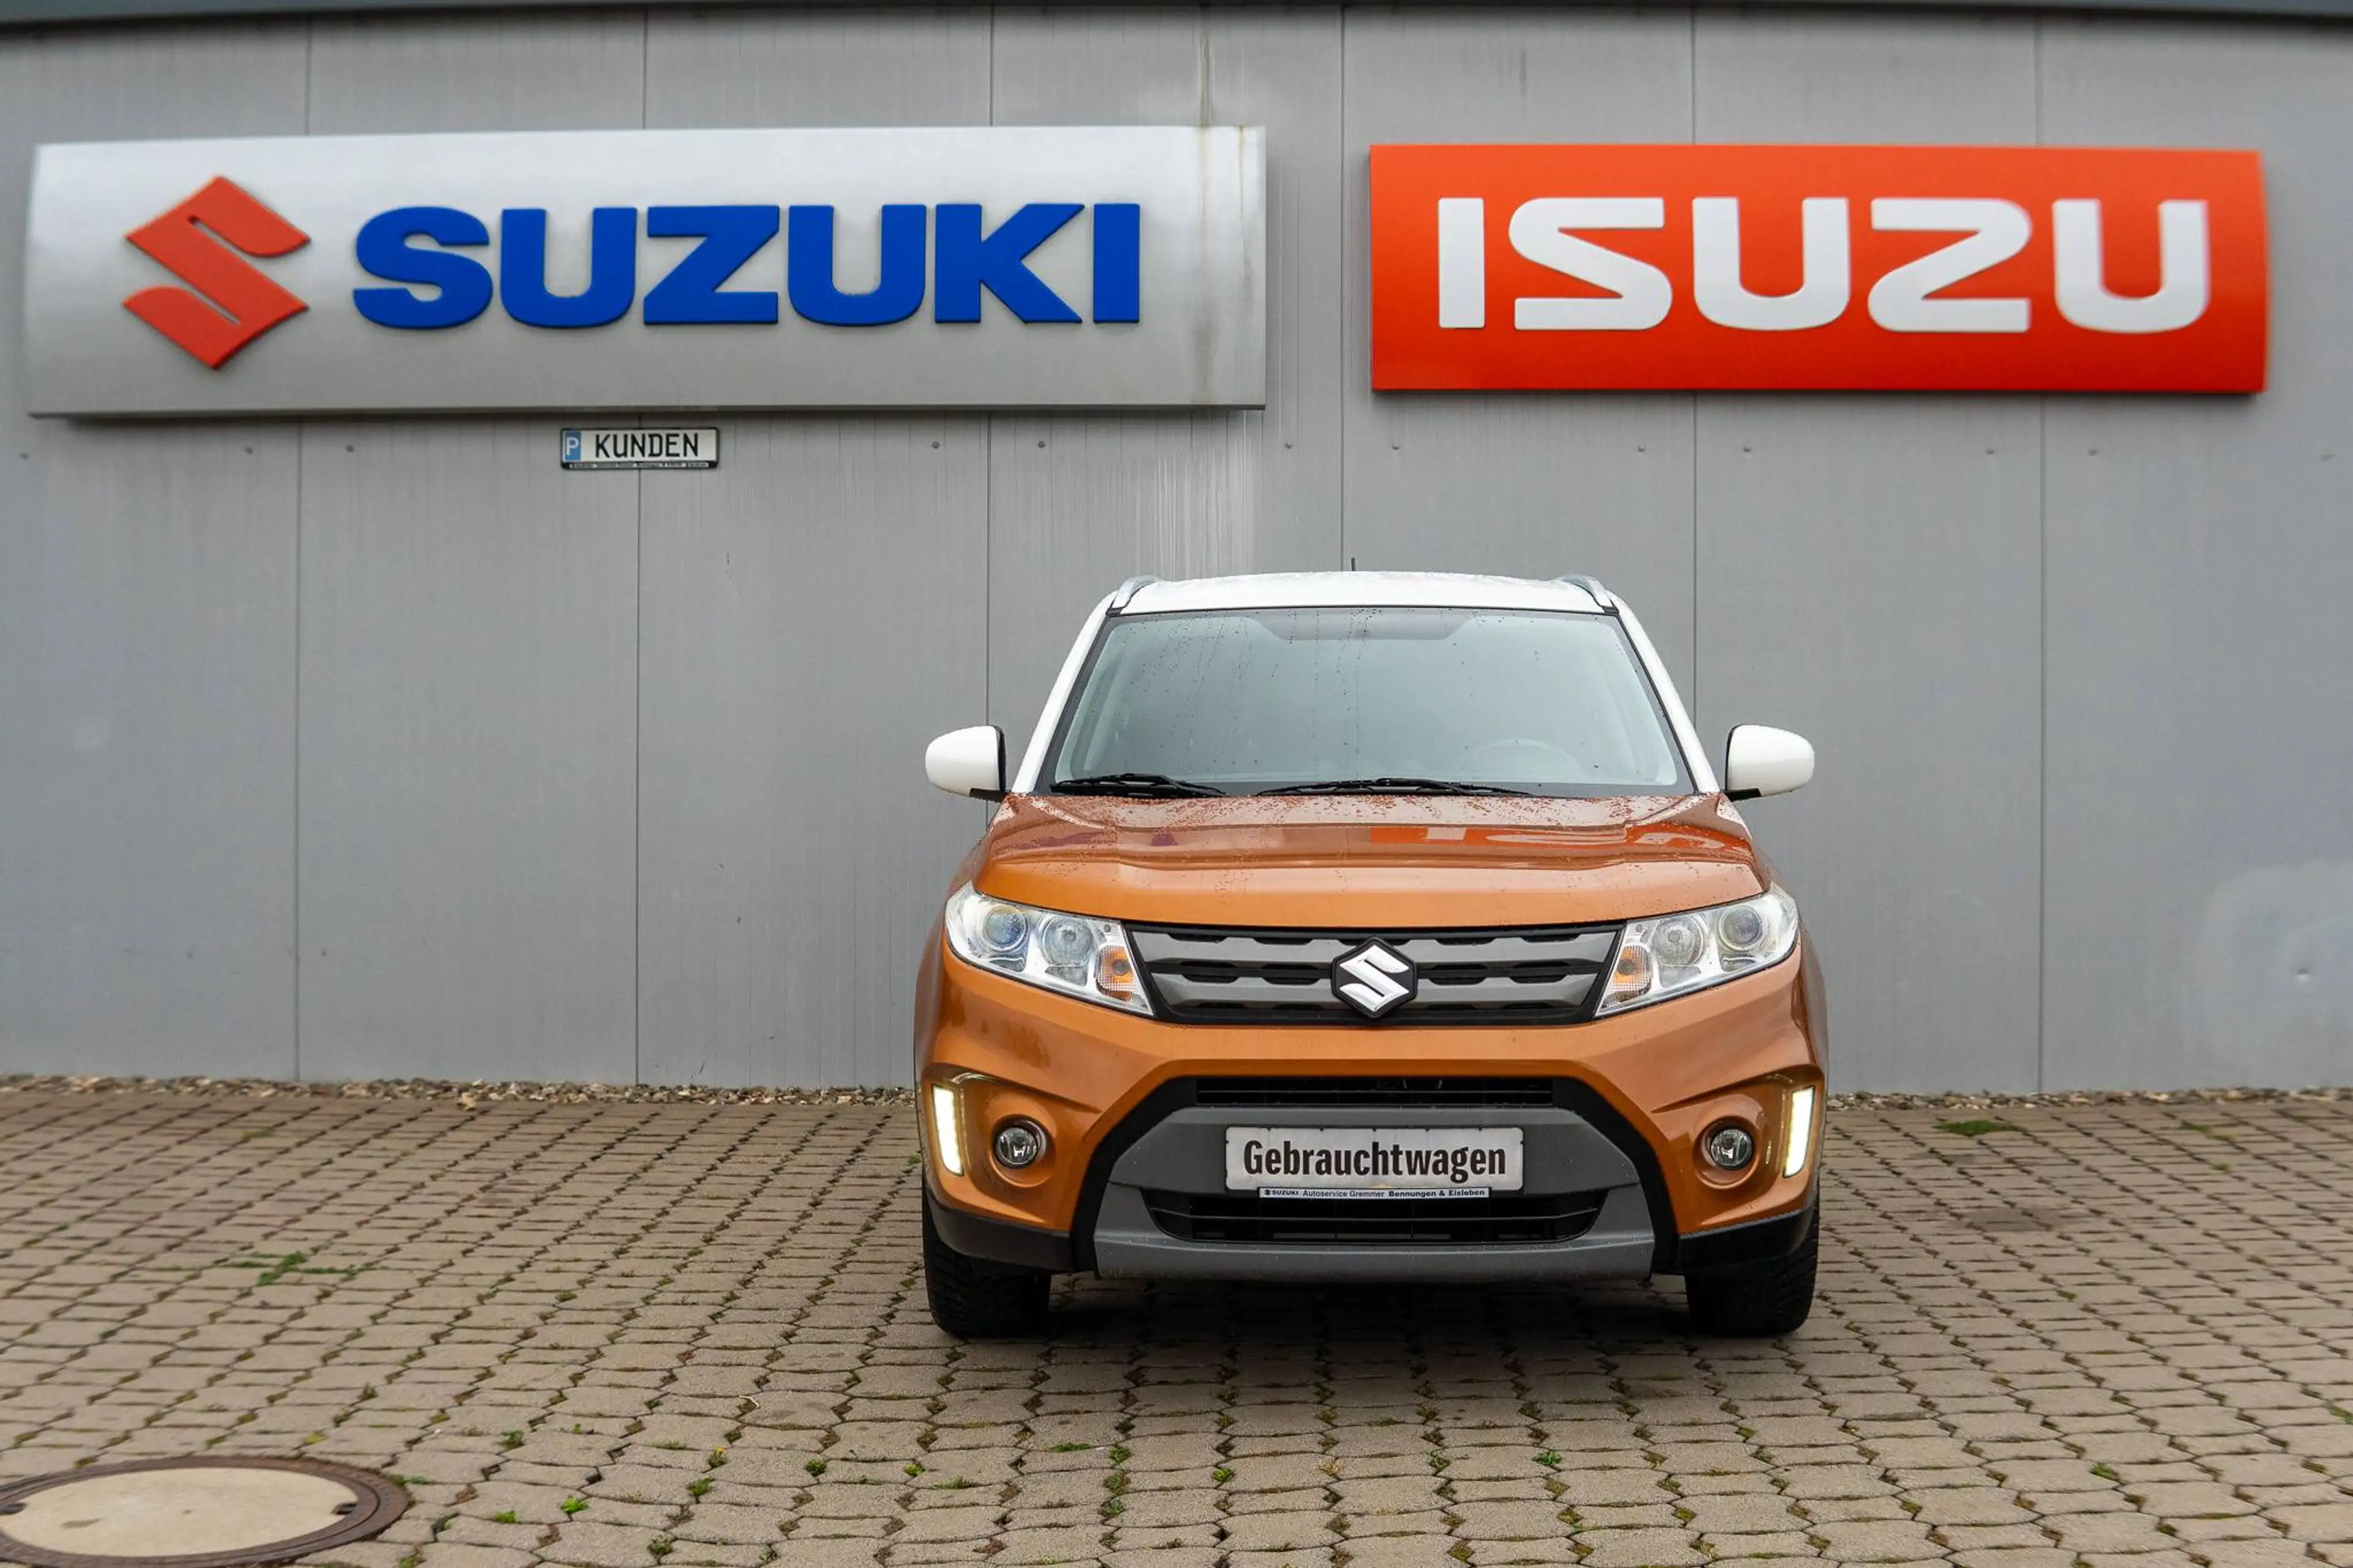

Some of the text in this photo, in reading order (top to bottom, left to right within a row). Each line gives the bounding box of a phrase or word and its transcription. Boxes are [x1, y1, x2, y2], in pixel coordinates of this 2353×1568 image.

[352, 202, 1142, 328] SUZUKI
[1438, 197, 2208, 332] ISUZU
[566, 437, 579, 456] P
[596, 433, 699, 458] KUNDEN
[1244, 1140, 1506, 1184] Gebrauchtwagen
